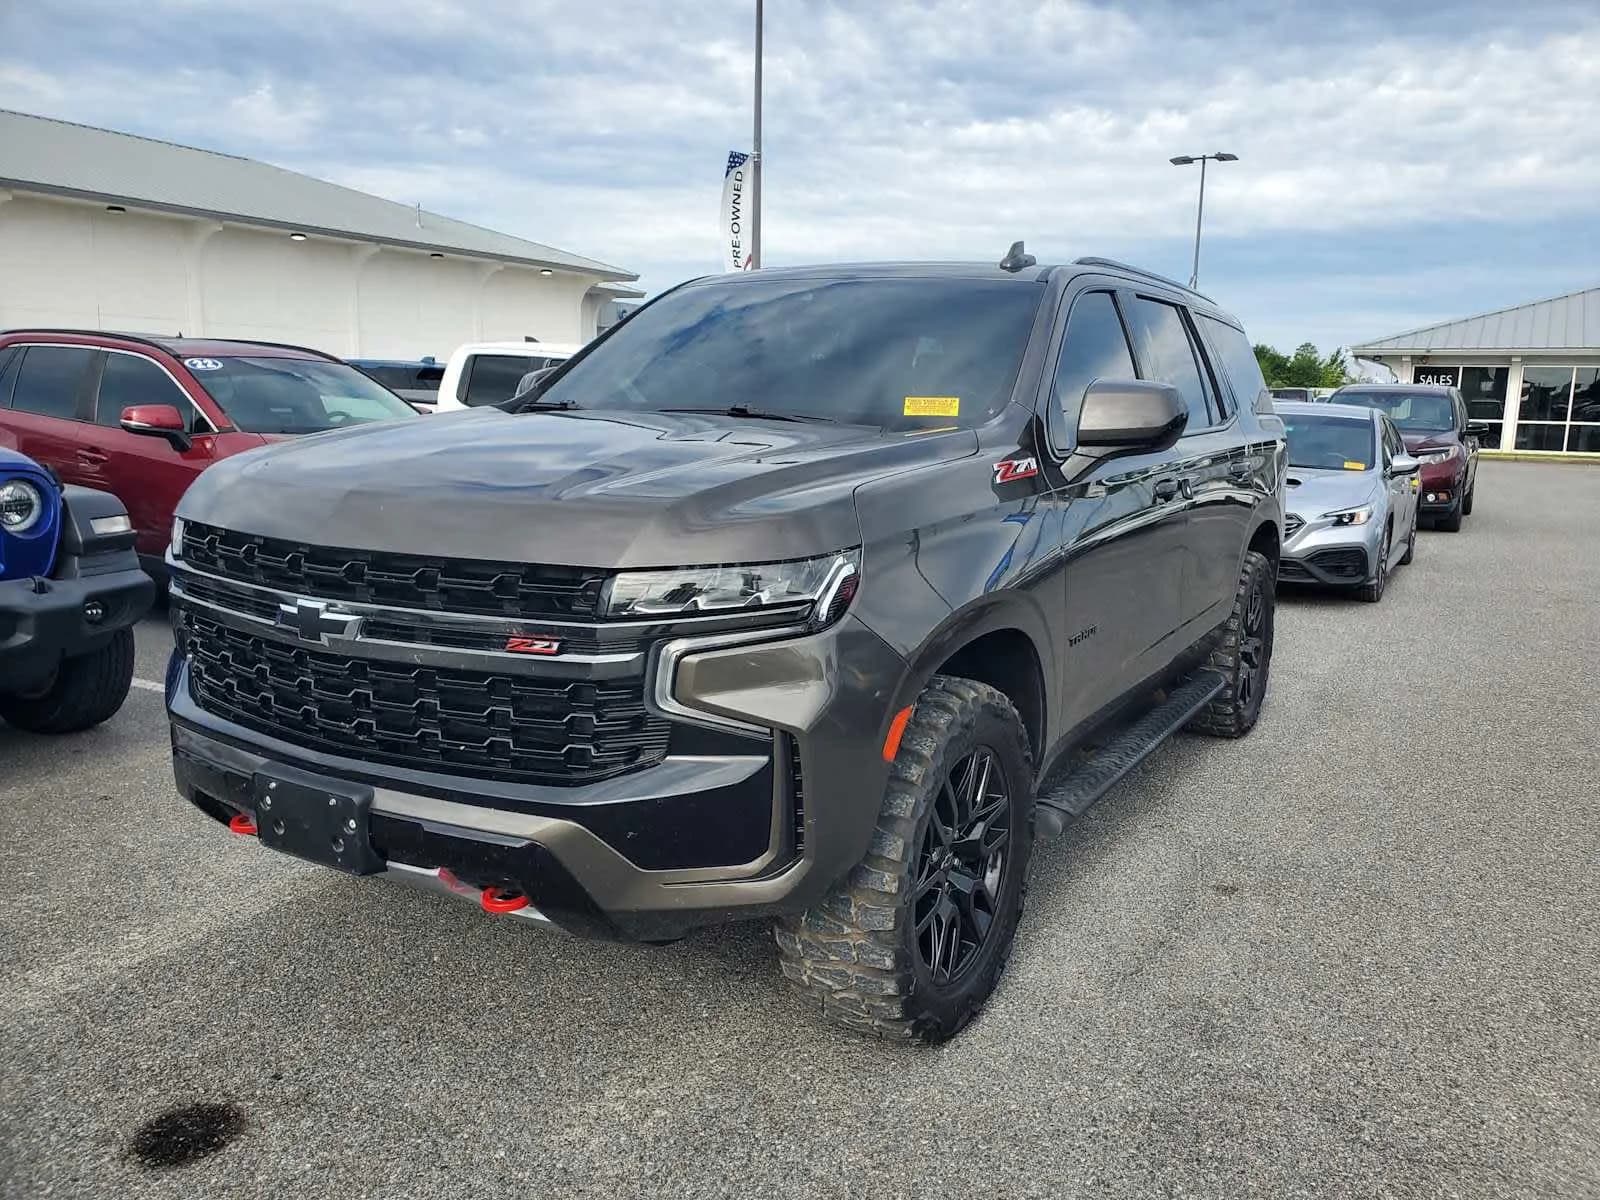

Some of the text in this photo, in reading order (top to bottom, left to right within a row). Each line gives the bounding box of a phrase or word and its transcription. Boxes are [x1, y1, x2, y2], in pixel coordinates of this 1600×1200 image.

[731, 170, 743, 268] PRE-OWNED
[1419, 374, 1453, 386] SALES
[992, 457, 1038, 484] Z71
[506, 637, 560, 655] Z71
